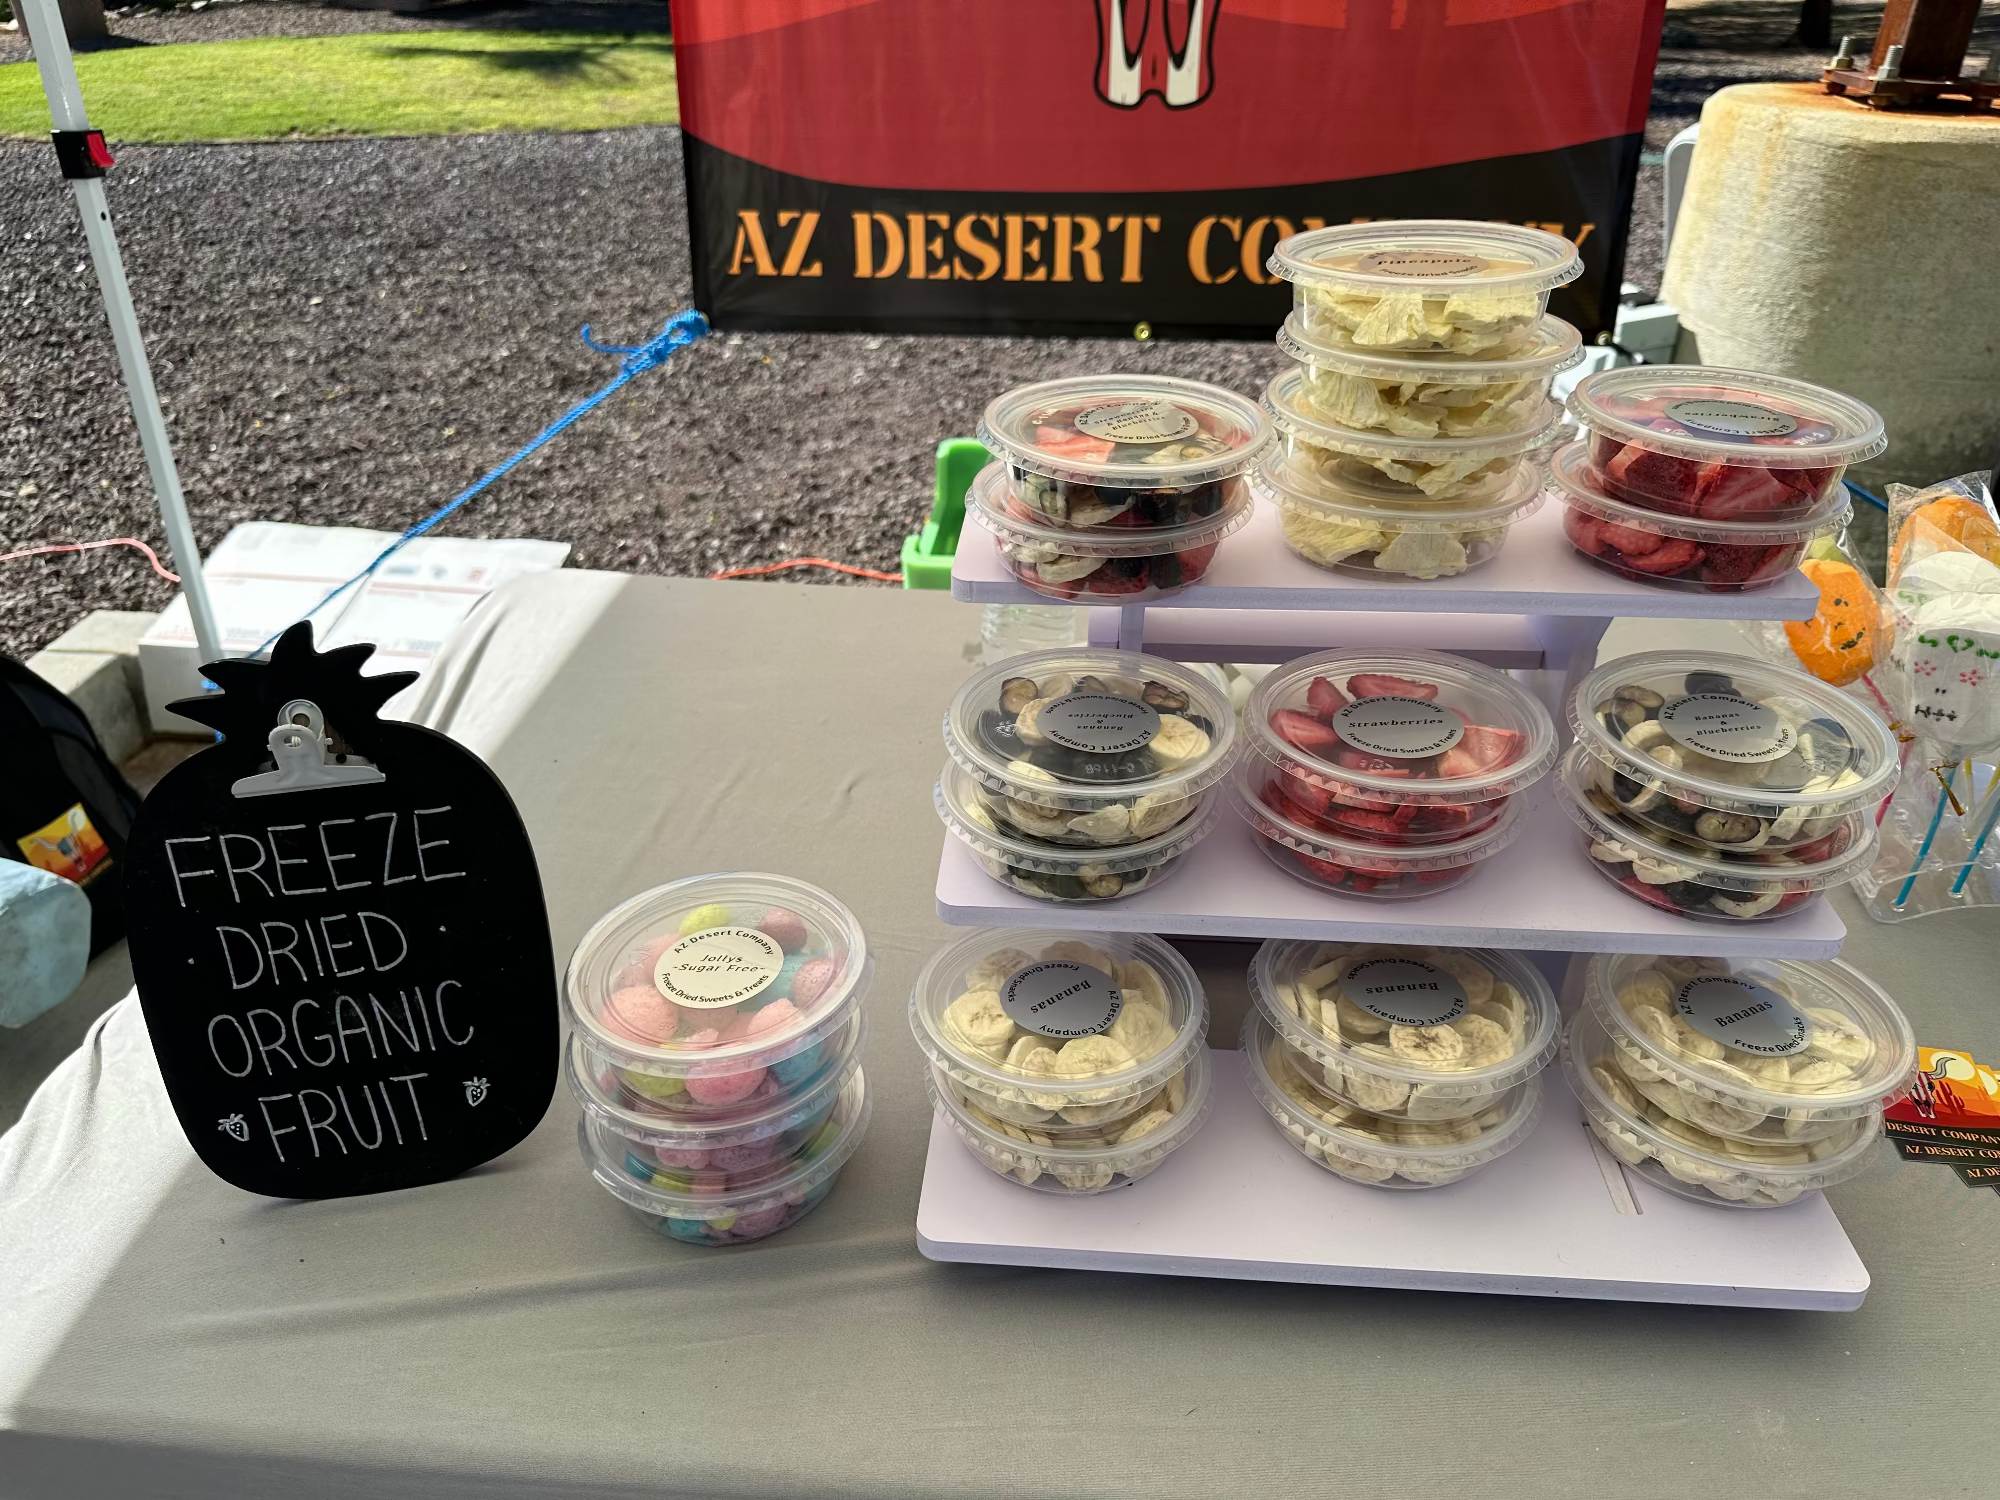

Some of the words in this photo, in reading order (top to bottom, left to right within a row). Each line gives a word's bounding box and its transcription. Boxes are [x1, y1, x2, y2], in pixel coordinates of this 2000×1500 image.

[728, 209, 823, 277] AZ
[851, 211, 1161, 282] DESERT
[1341, 708, 1354, 718] AZ
[1350, 697, 1386, 709] Desert
[1391, 696, 1444, 713] Company
[1664, 711, 1674, 721] AZ
[1670, 696, 1699, 712] Desert
[1701, 694, 1761, 711] Company
[1348, 718, 1444, 728] Strawberries
[1695, 712, 1740, 721] Bananas
[1139, 729, 1152, 740] AZ
[1696, 725, 1761, 736] Blueberries
[1049, 730, 1096, 751] Company
[1101, 738, 1141, 751] Desert
[1347, 732, 1372, 747] Freeze
[1372, 744, 1398, 753] Dried
[1400, 745, 1434, 753] Sweets
[1439, 728, 1457, 744] Treats
[1685, 737, 1717, 753] Freeze
[1719, 749, 1746, 758] Dried
[1747, 747, 1779, 757] Sweets
[165, 806, 467, 907] FREEZE
[216, 911, 407, 989] DRIED
[674, 942, 689, 954] AZ
[689, 930, 732, 944] Desert
[735, 930, 774, 955] Company
[699, 954, 744, 964] Jollys
[1370, 958, 1397, 966] Dried
[1399, 958, 1436, 973] Freeze
[1019, 966, 1044, 980] Dried
[1044, 963, 1080, 971] Freeze
[662, 972, 677, 993] Freeze
[675, 989, 698, 1002] Dried
[699, 993, 734, 1003] Sweets
[734, 990, 743, 998] &
[743, 974, 769, 993] Treats
[1366, 982, 1440, 995] Bananas
[1698, 976, 1755, 990] Company
[1008, 979, 1022, 1003] Snacks
[1030, 980, 1092, 1014] Bananas
[1108, 990, 1119, 1001] AZ
[1679, 980, 1698, 1003] Desert
[1453, 997, 1464, 1009] AZ
[1681, 1004, 1695, 1015] AZ
[1097, 1002, 1120, 1029] Desert
[1366, 1004, 1425, 1026] Company
[1429, 1007, 1461, 1025] Desert
[1714, 1001, 1773, 1028] Bananas
[207, 979, 474, 1077] ORGANIC
[1039, 1024, 1097, 1036] Company
[1734, 1039, 1775, 1053] Freeze
[1775, 1038, 1800, 1052] Dried
[258, 1073, 428, 1162] FRUIT
[1886, 1122, 1936, 1136] DESERT
[1905, 1144, 1923, 1154] AZ
[1924, 1146, 1975, 1157] DESERT
[1966, 1168, 1985, 1178] AZ
